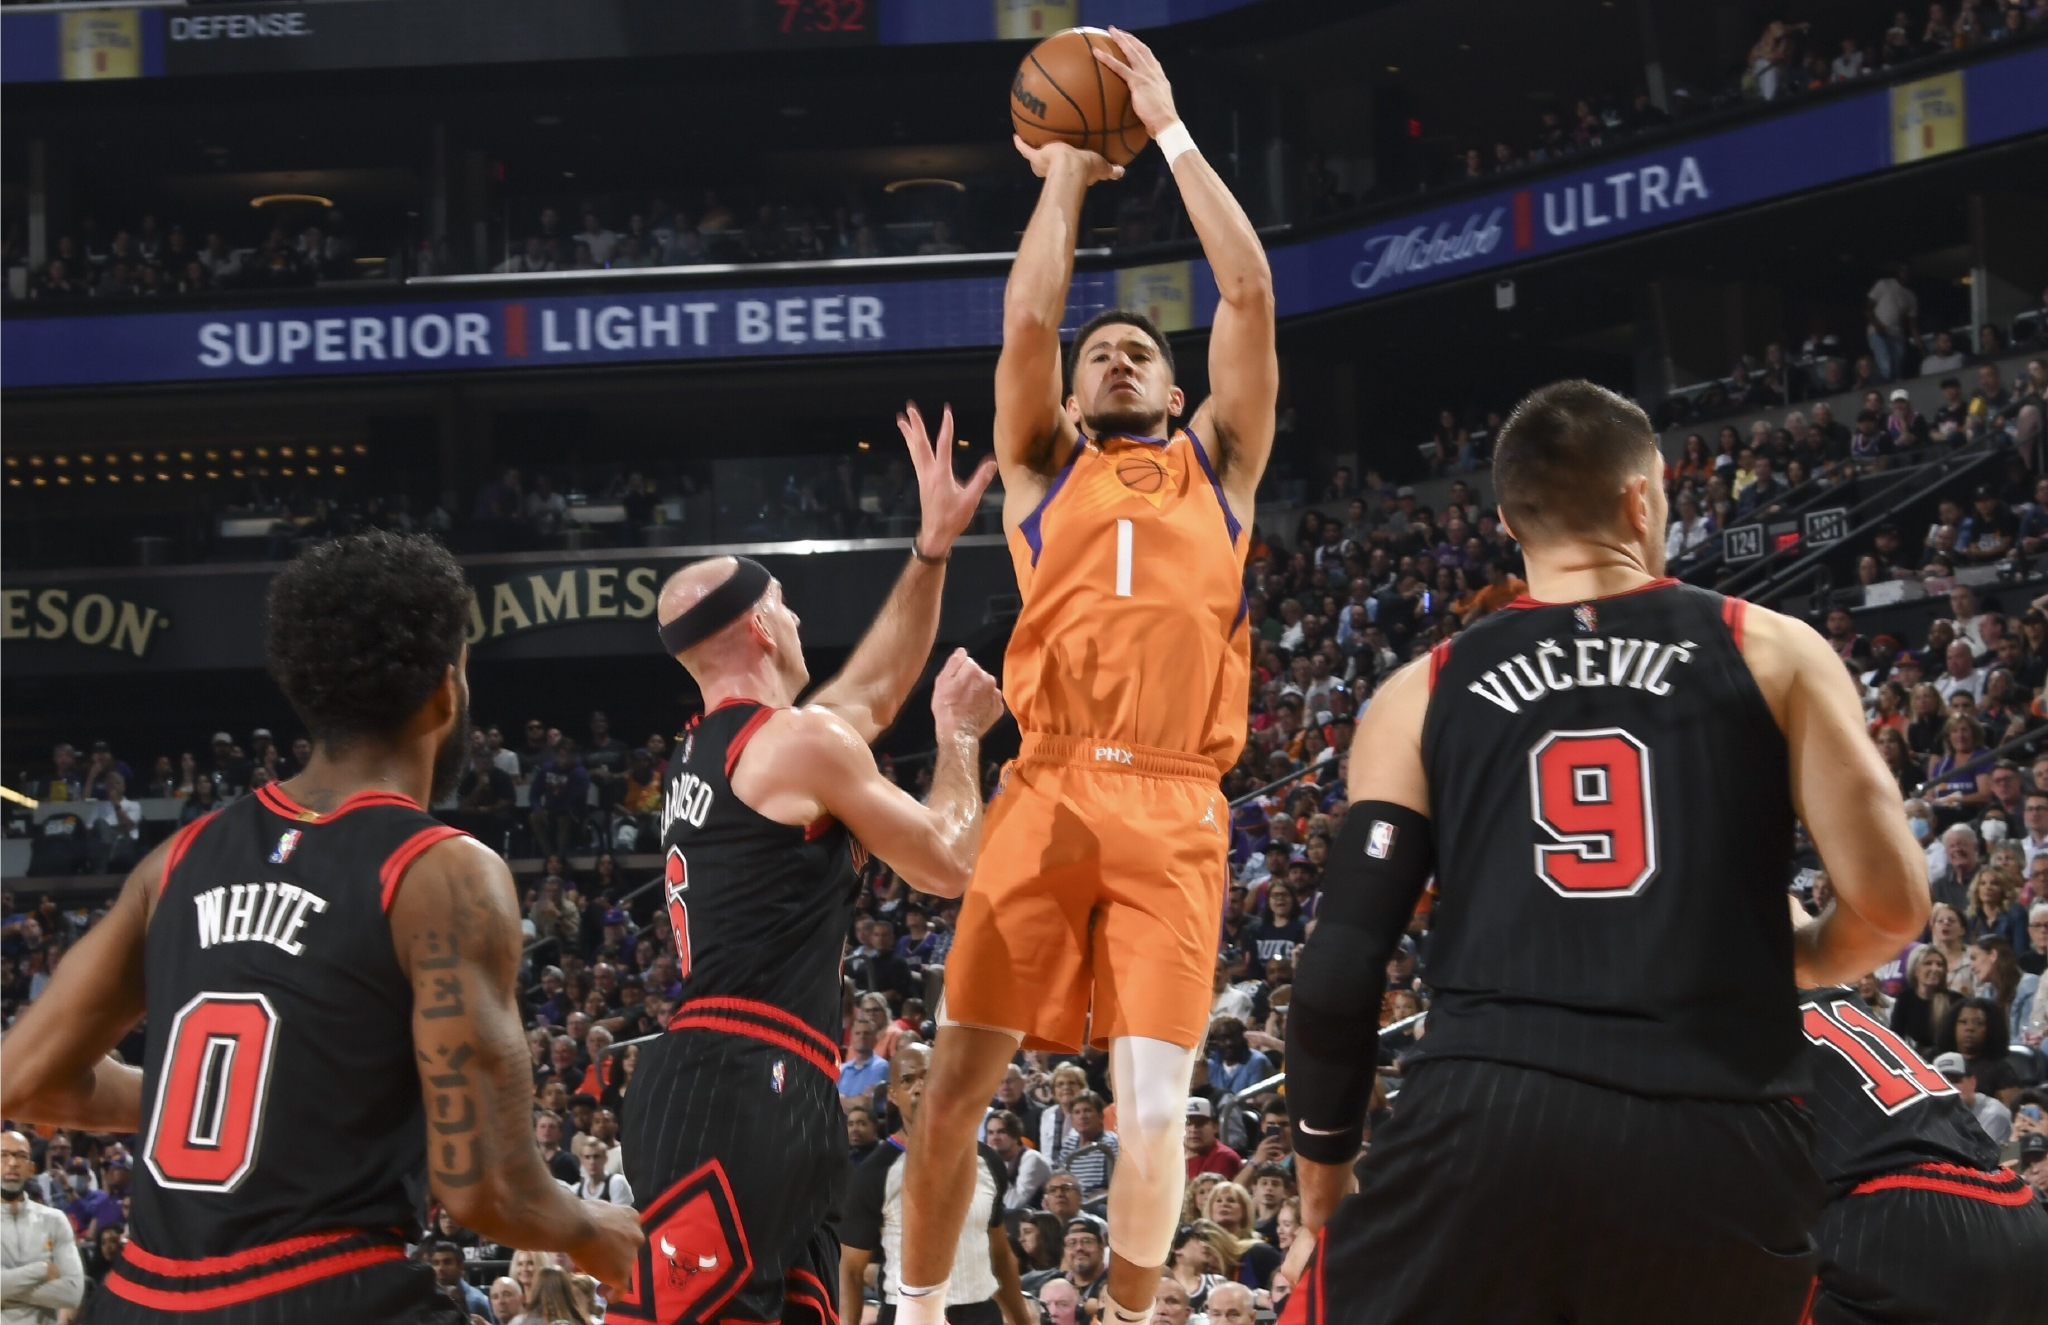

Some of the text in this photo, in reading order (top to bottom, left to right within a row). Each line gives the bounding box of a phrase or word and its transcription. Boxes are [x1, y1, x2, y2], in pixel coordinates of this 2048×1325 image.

[777, 0, 866, 33] 7:32
[1543, 156, 1708, 236] ULTRA
[198, 295, 885, 367] SUPERIOR LIGHT BEER
[1115, 518, 1133, 597] 1
[1730, 530, 1757, 556] 124
[1467, 637, 1699, 714] VUČEVIĆ
[1094, 746, 1134, 767] PHX
[1528, 727, 1658, 898] 9
[193, 887, 330, 957] WHITE
[143, 991, 281, 1193] 0
[1797, 999, 1962, 1117] 11
